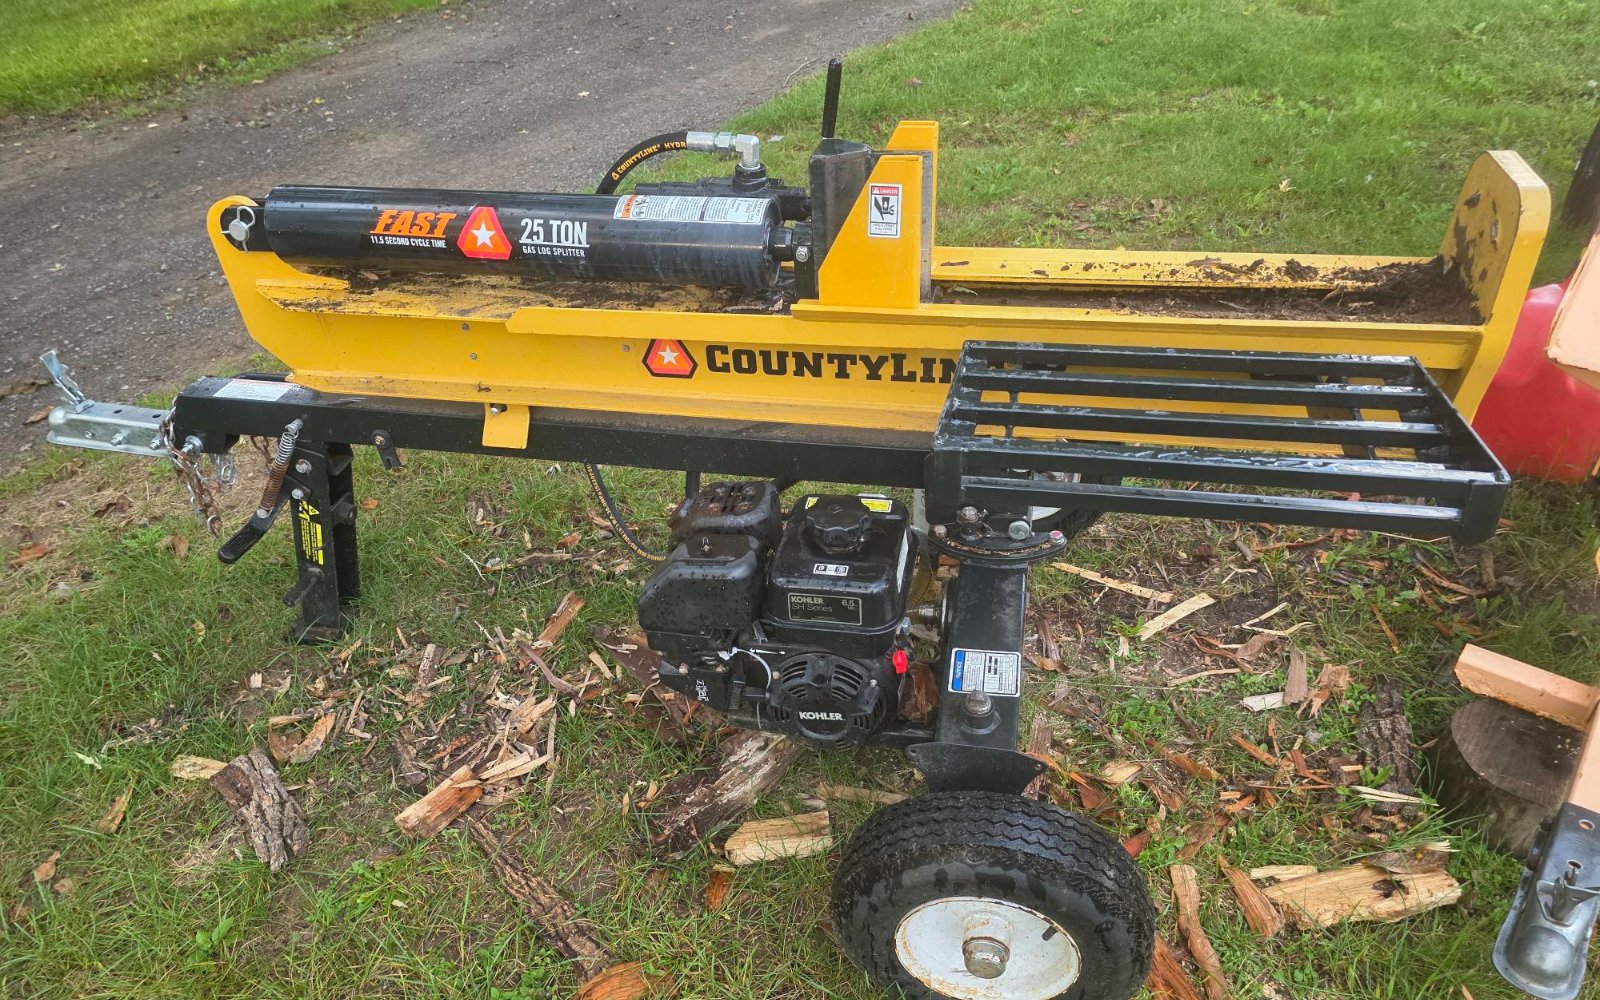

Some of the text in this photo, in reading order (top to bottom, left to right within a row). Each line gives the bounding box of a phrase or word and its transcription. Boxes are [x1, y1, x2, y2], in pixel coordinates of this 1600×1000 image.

[372, 209, 457, 237] FAST
[520, 218, 588, 247] 25 TON
[370, 235, 448, 249] 11.5 SECOND CYCLE TIME
[522, 245, 585, 258] GAS LOG SPLITTER
[705, 344, 958, 383] COUNTYLIN
[790, 595, 824, 605] KOHLER
[791, 603, 833, 613] SH Series
[798, 711, 844, 721] KOHLER
